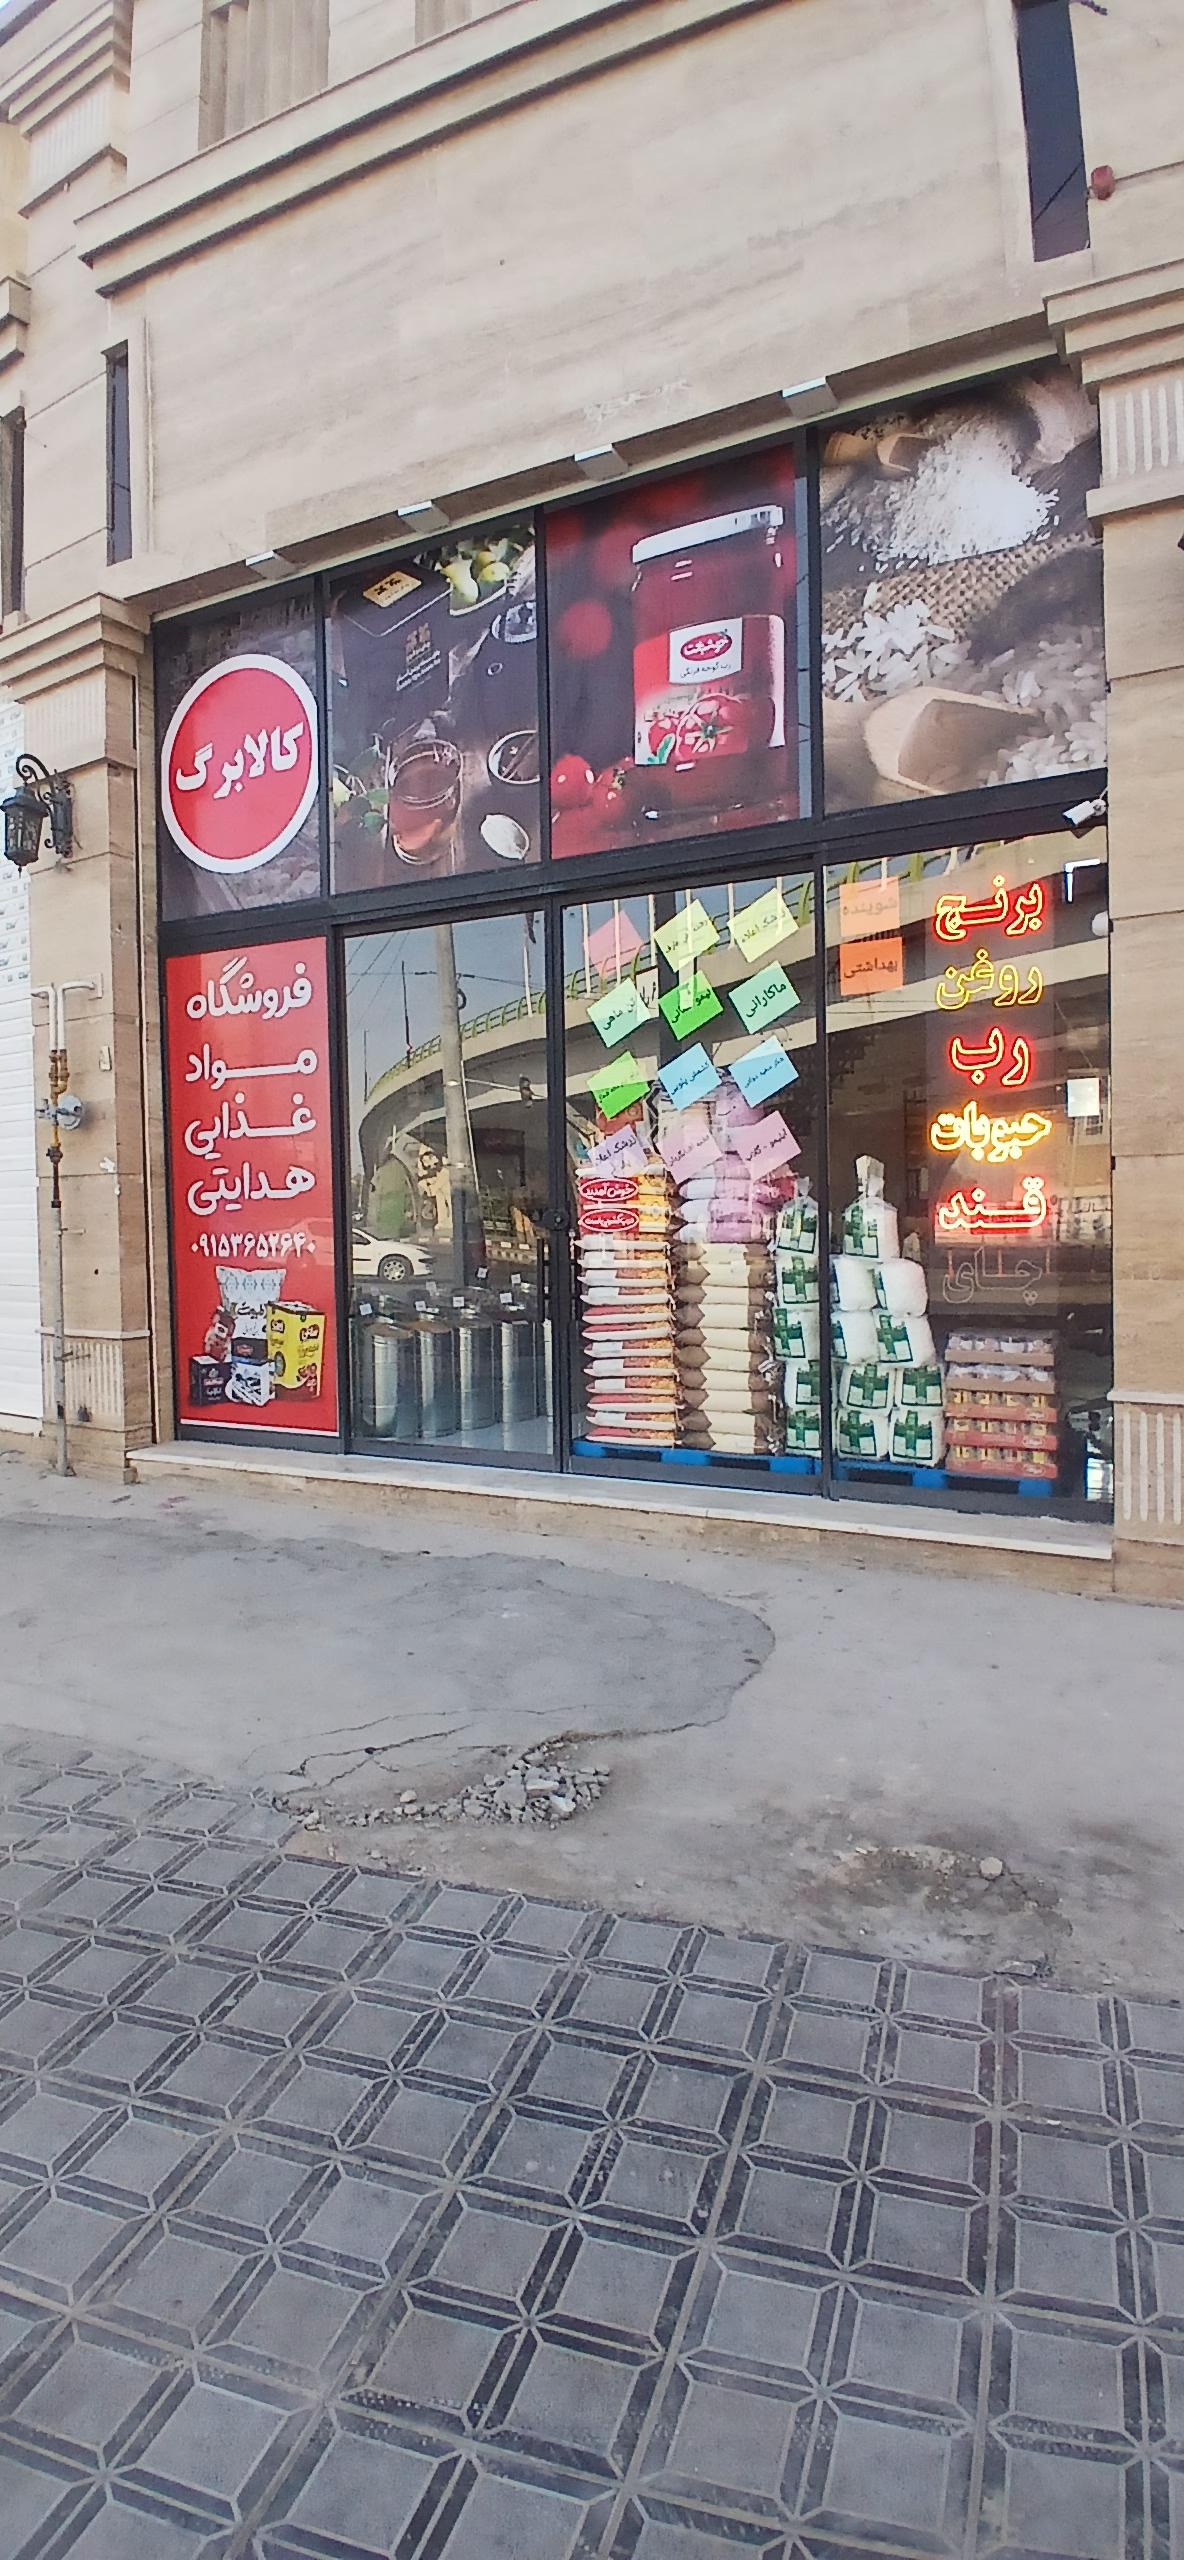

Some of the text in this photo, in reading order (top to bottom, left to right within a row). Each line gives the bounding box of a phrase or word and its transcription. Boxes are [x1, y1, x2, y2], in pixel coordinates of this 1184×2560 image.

[174, 721, 304, 799] کالابرگ
[935, 875, 1043, 940] برنج
[186, 956, 312, 1019] فروشگاه
[844, 957, 899, 979] بهداشتی
[936, 949, 1043, 1010] روغن
[185, 1043, 318, 1090] مواد
[950, 1026, 1030, 1086] رب
[184, 1092, 317, 1159] غذایی
[930, 1100, 1052, 1163] حبوبات
[187, 1161, 316, 1215] هدایتی
[607, 1183, 635, 1198] خوش
[938, 1176, 1047, 1230] قند
[942, 1246, 1042, 1305] چای
